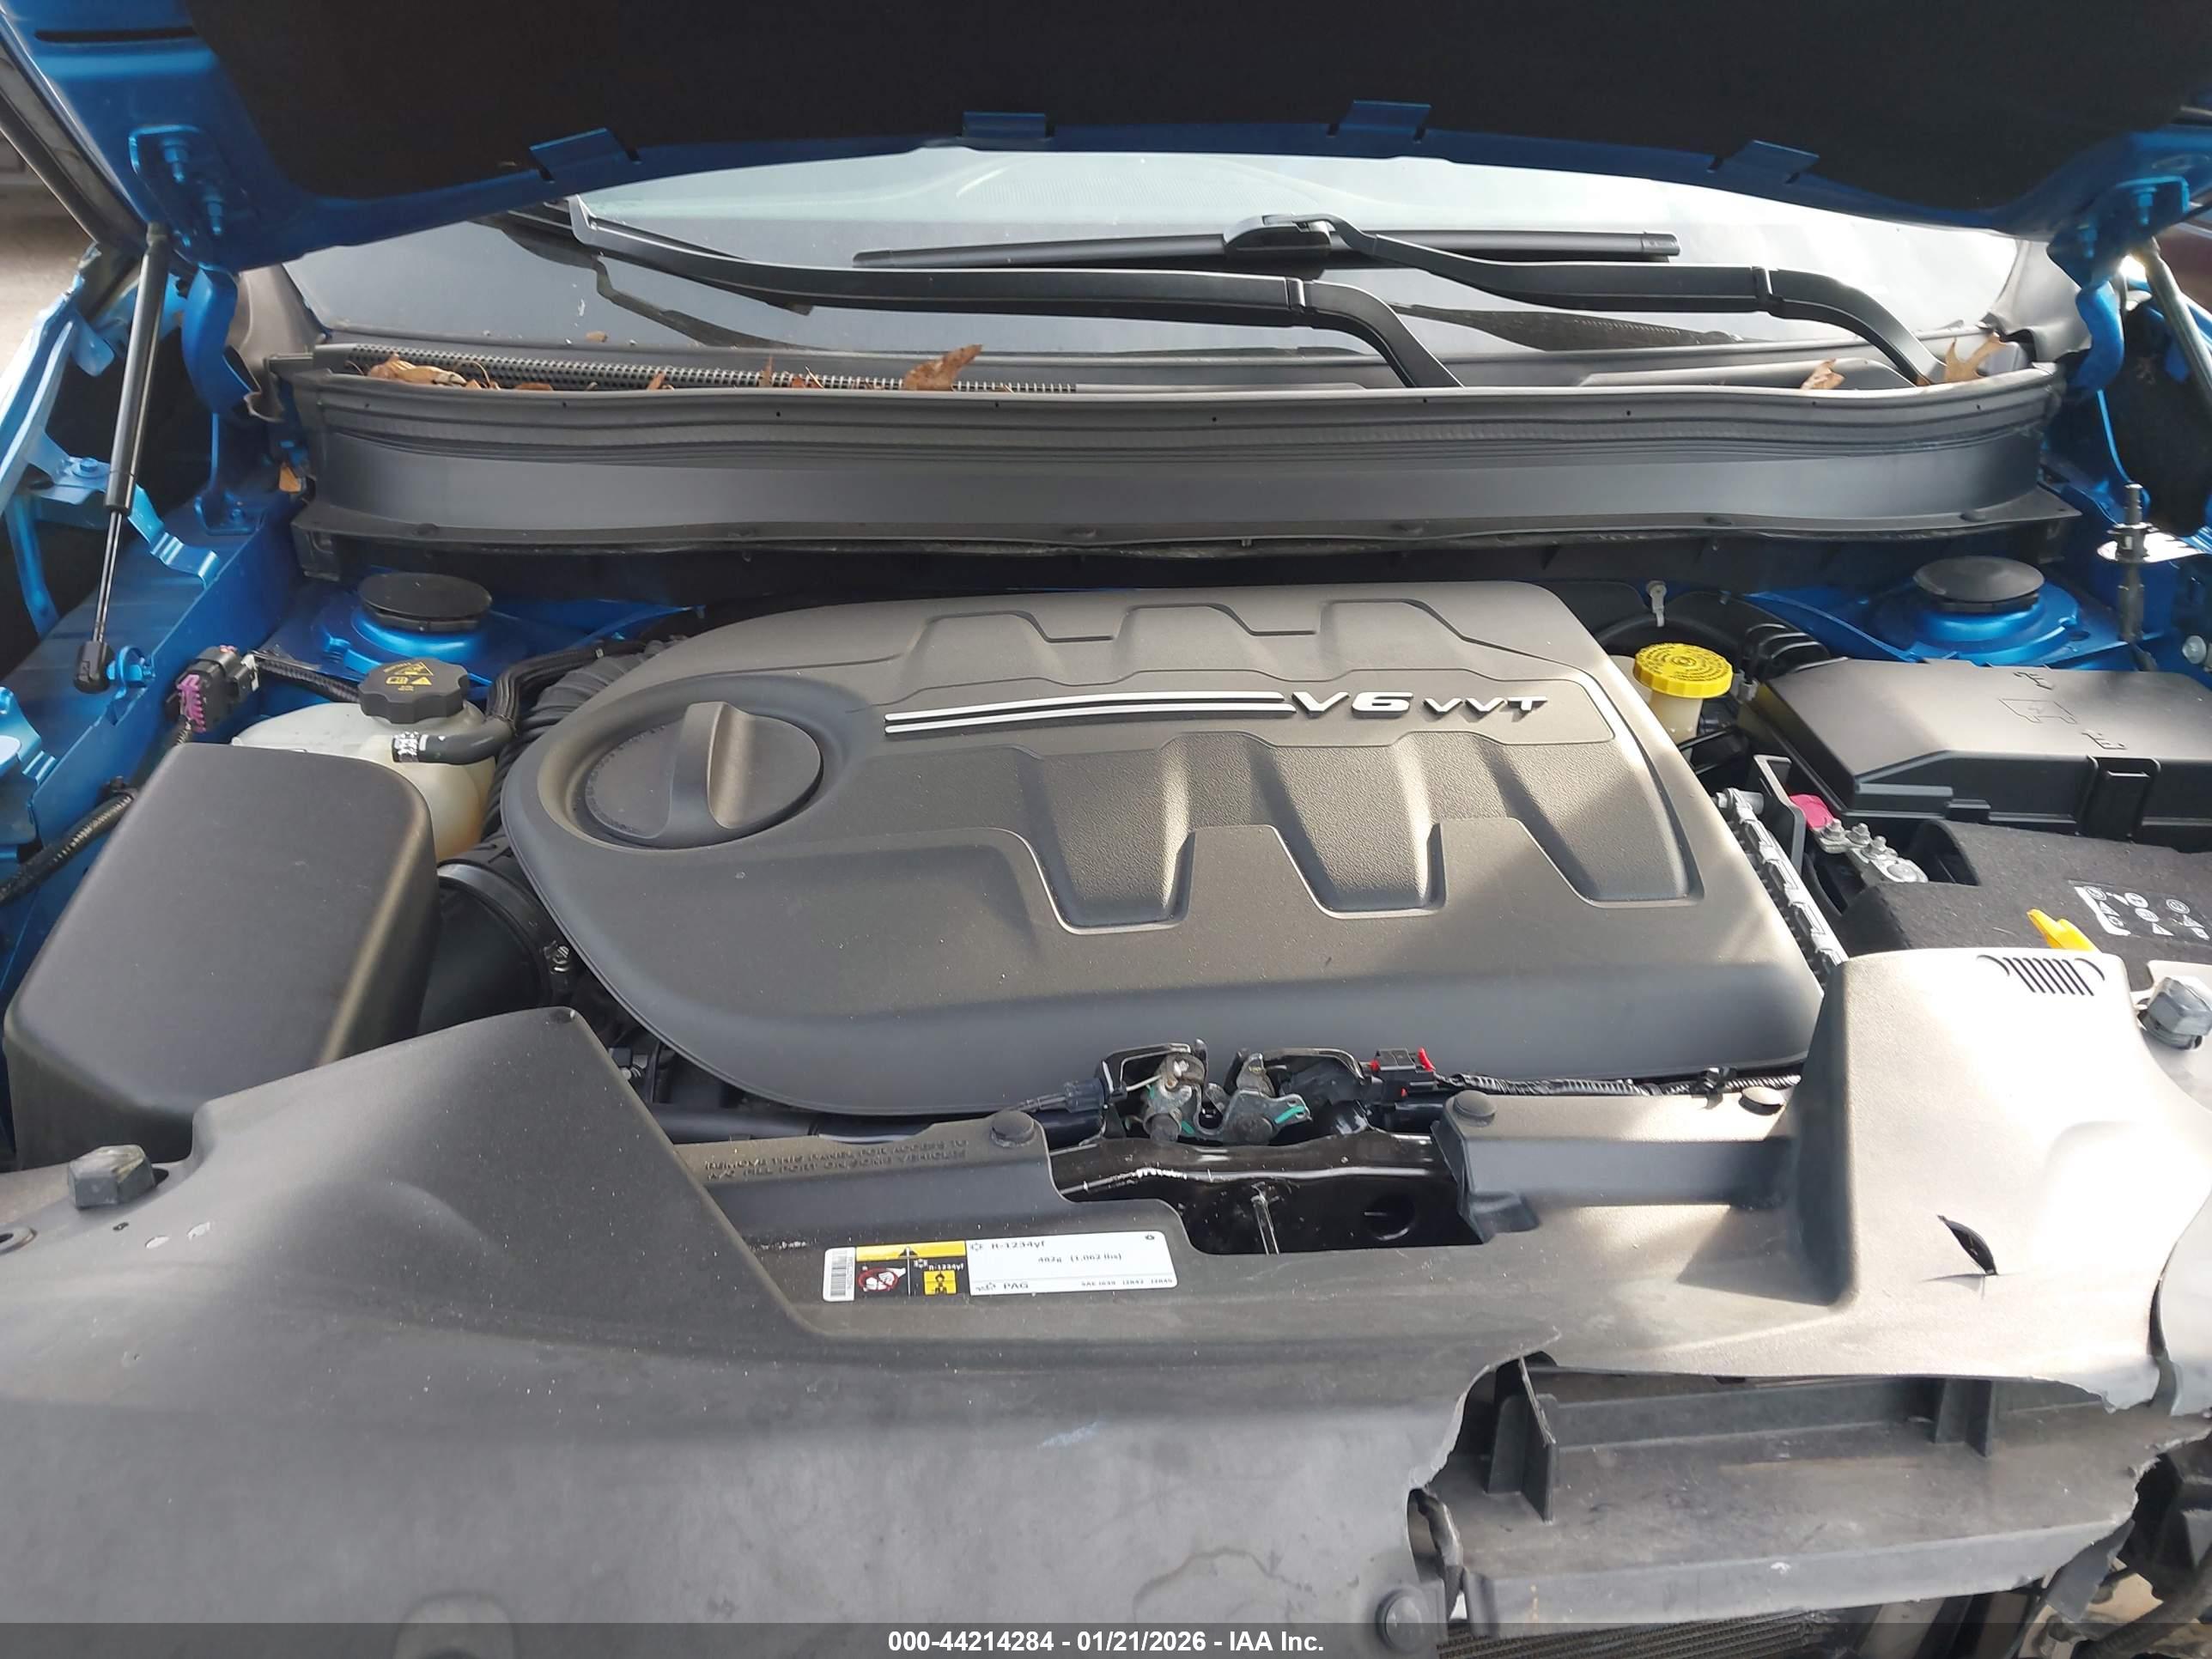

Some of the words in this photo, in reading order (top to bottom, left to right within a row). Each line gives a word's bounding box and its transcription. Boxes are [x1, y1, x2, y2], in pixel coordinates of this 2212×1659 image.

[1291, 691, 1413, 718] V6
[1422, 696, 1548, 714] VVT
[772, 1154, 804, 1164] THIS
[991, 1240, 1045, 1251] R-1234yf
